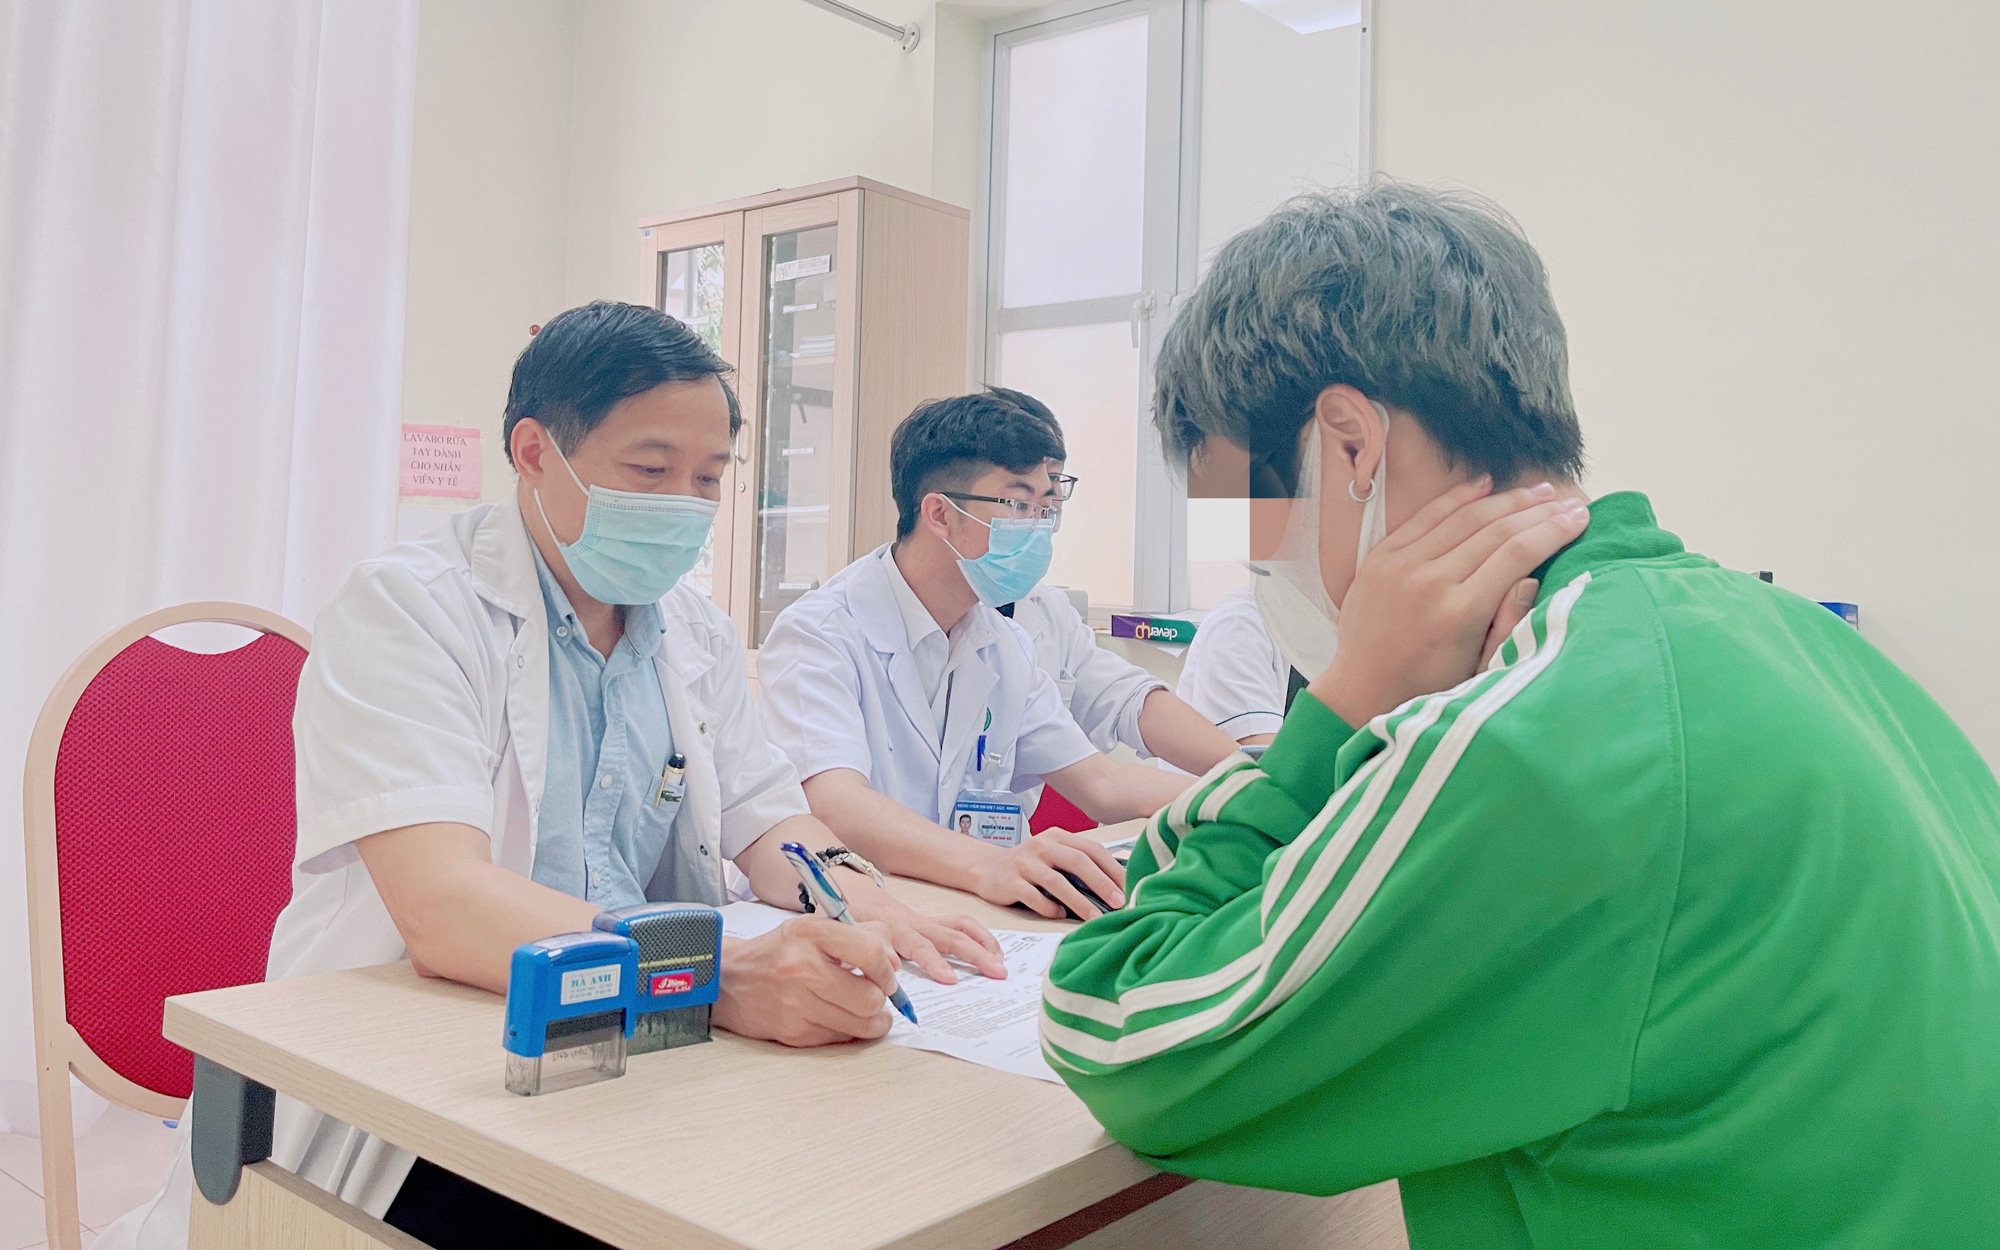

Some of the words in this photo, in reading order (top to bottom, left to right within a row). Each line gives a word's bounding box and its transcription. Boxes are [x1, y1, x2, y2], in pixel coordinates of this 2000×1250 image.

[404, 433, 444, 443] LAVABO
[411, 447, 431, 456] TAY
[434, 447, 461, 459] DÀNH
[410, 461, 431, 470] CHO
[433, 461, 461, 472] NHÂN
[413, 474, 434, 484] VIÊN
[437, 477, 444, 485] Y
[589, 973, 611, 985] ANH
